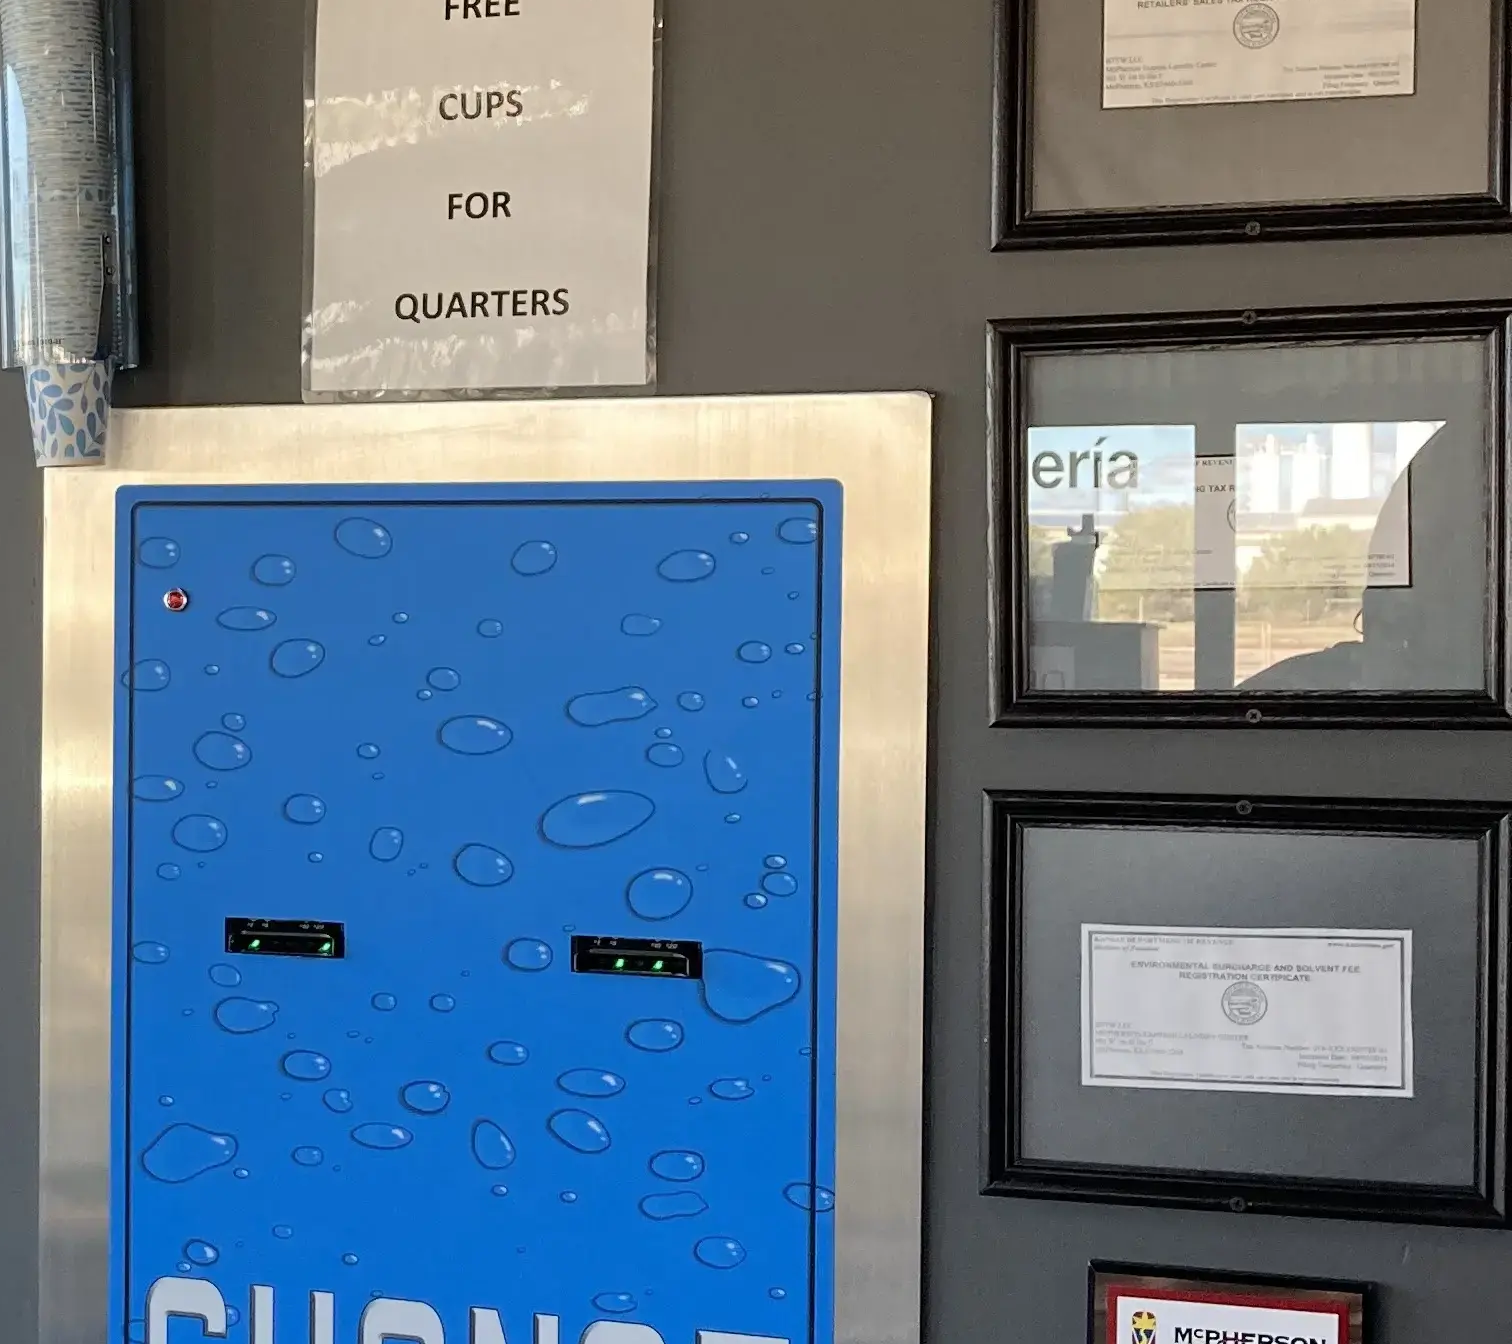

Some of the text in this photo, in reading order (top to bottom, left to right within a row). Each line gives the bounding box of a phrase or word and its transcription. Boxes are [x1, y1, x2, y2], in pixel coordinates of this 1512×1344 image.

[438, 89, 524, 121] CUPS
[447, 191, 512, 220] FOR
[394, 287, 570, 324] QUARTERS
[1208, 484, 1226, 493] TAX
[1130, 960, 1209, 971] ENVIRONMENTAL
[1273, 964, 1294, 972] AND
[1178, 971, 1311, 982] REGISTRATION CERTIFICATE
